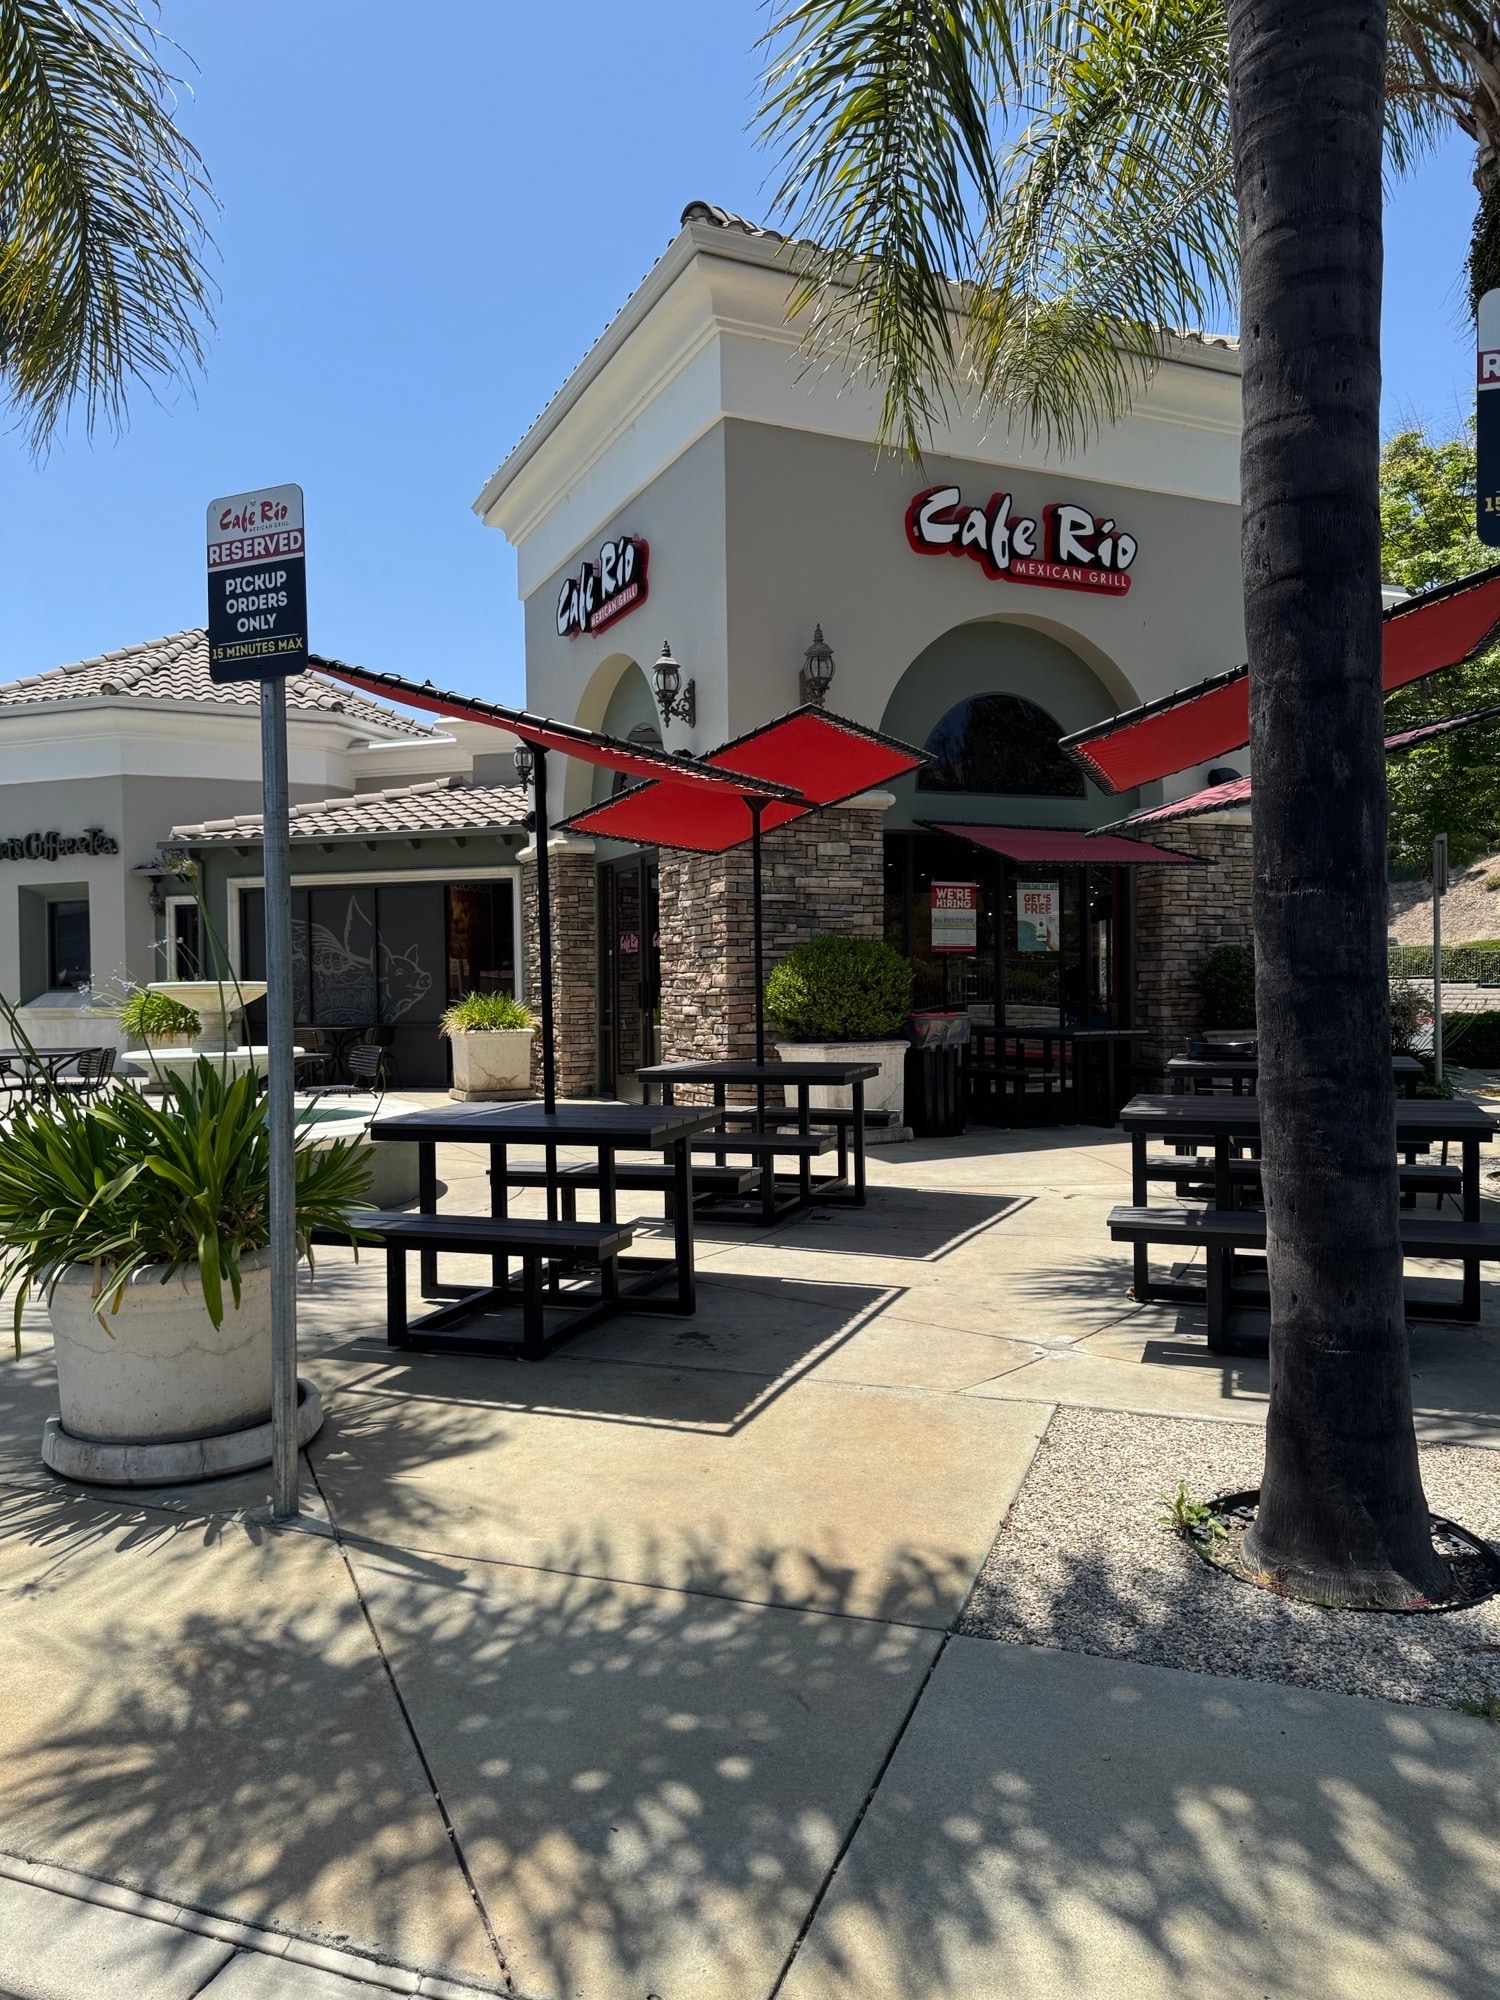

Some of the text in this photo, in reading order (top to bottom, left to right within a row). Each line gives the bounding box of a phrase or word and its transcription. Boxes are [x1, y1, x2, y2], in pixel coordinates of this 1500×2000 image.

[220, 505, 256, 533] Cafe
[249, 520, 290, 532] MEXICAN GRILL
[918, 486, 1037, 569] Cafe
[209, 531, 302, 564] RESERVED
[225, 570, 287, 595] PICKUP
[1016, 561, 1128, 588] MEXICAN GRILL
[226, 591, 288, 614] ORDERS
[556, 563, 595, 635] Cafe
[591, 583, 638, 628] MEXICAN GRILL
[237, 613, 277, 633] ONLY
[212, 637, 304, 660] 15 MINUTES MAX
[23, 831, 76, 861] Coffee
[936, 888, 972, 899] WE'RE
[936, 899, 972, 909] HIRING
[1024, 893, 1042, 903] GET
[1024, 903, 1052, 914] FREE
